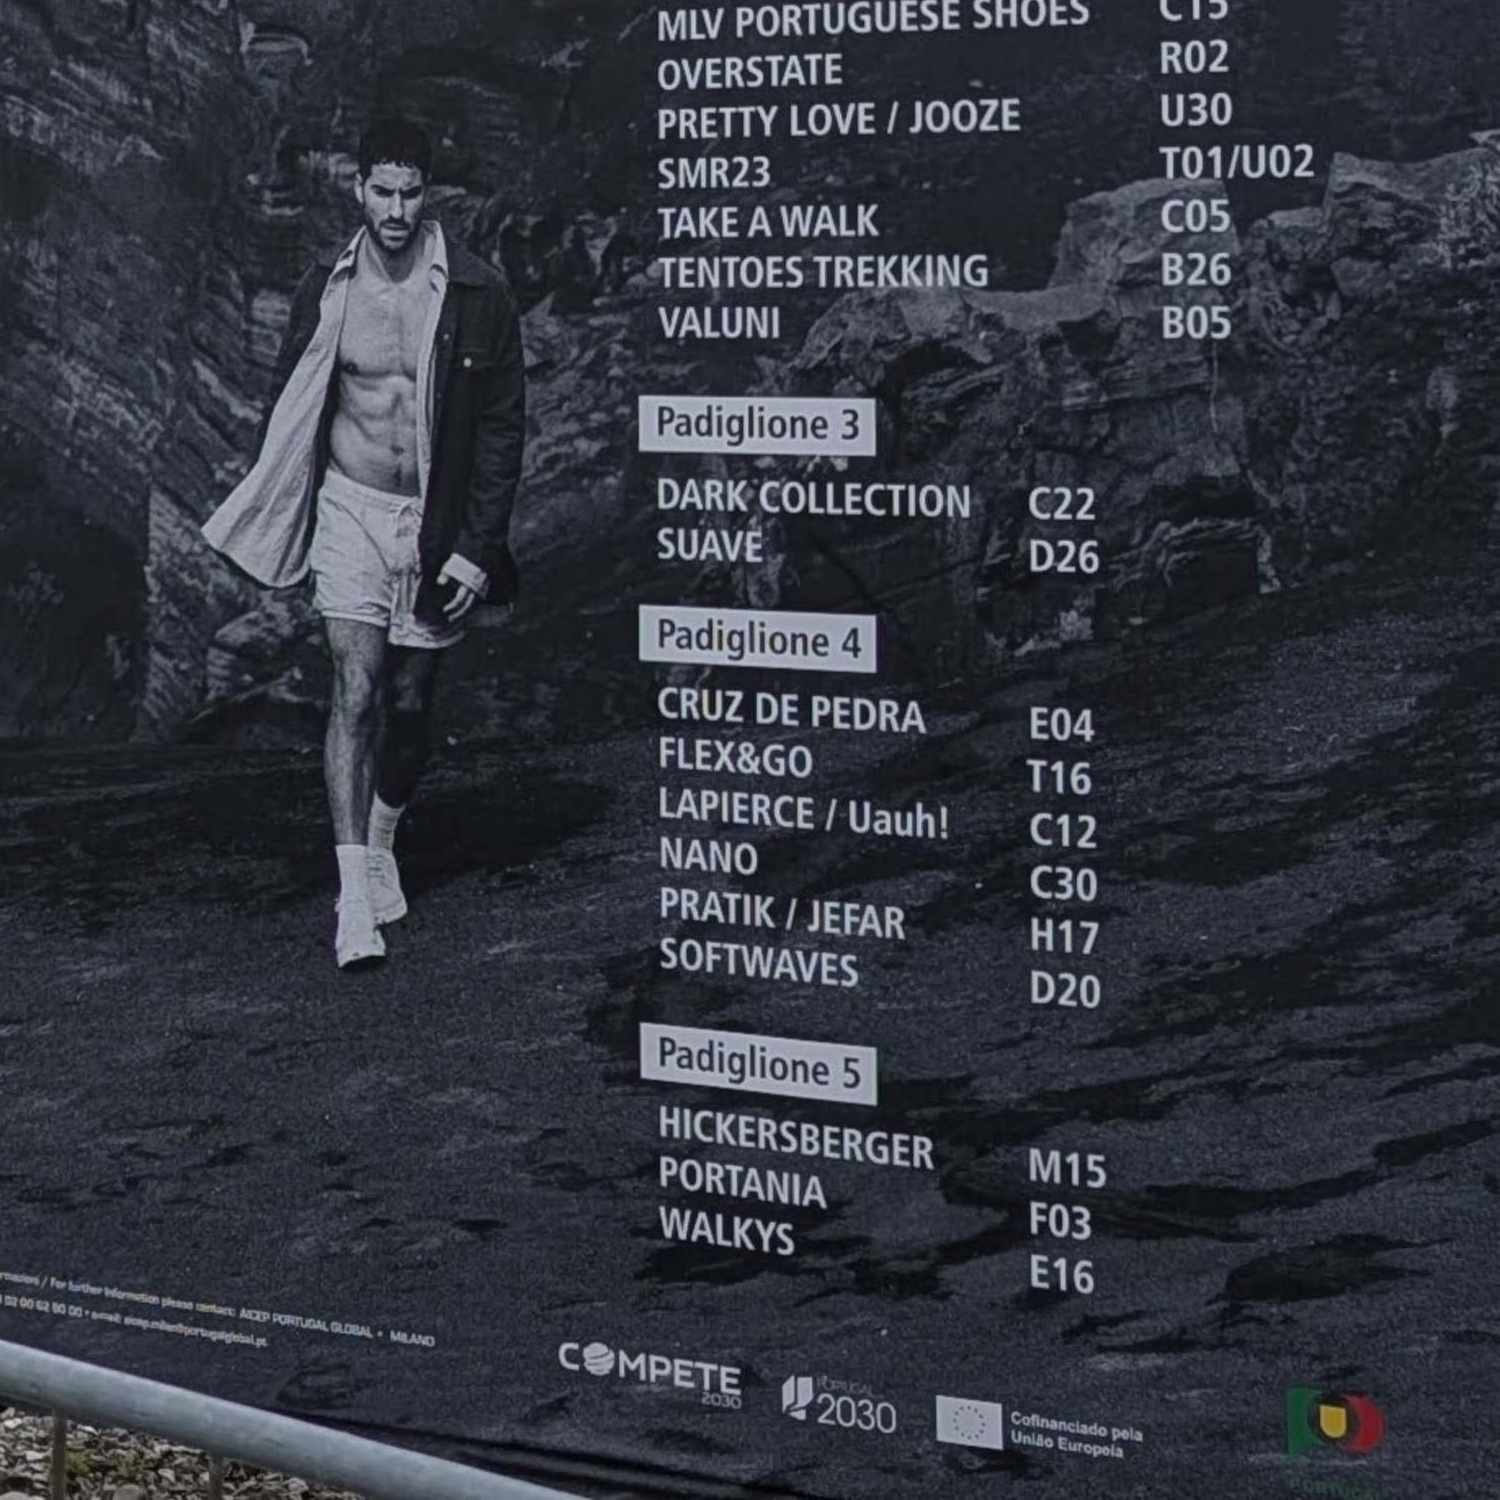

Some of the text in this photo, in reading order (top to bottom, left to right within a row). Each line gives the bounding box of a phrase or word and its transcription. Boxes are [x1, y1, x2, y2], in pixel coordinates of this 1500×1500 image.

[658, 7, 725, 42] MLV
[658, 53, 843, 91] OVERSTATE
[1160, 38, 1229, 74] R02
[658, 105, 779, 140] PRETTY
[790, 102, 876, 136] LOVE
[909, 97, 1021, 134] JOOZE
[1161, 92, 1233, 127] U30
[658, 155, 771, 190] SMR23
[1159, 143, 1315, 181] T01/U02
[657, 204, 879, 239] TAKE A WALK
[1161, 199, 1231, 232] C05
[658, 253, 990, 289] TENTOES TREKKING
[1161, 252, 1231, 286] B26
[658, 306, 781, 339] VALUNI
[1162, 305, 1231, 339] B05
[657, 404, 859, 447] Padiglione 3
[658, 478, 971, 519] DARK COLLECTION
[1029, 487, 1096, 521] C22
[657, 527, 765, 563] SUAVE
[1029, 540, 1100, 574] D26
[658, 618, 862, 662] Padiglione 4
[658, 686, 927, 734] CRUZ DE PEDRA
[1030, 706, 1095, 742] E04
[659, 736, 813, 778] FLEX&GO
[1026, 759, 1092, 795] T16
[659, 786, 815, 830] LAPIERCE
[849, 800, 948, 839] Uauh!
[1030, 812, 1097, 849] C12
[660, 836, 758, 875] NANO
[1030, 865, 1098, 902] C30
[660, 886, 776, 928] PRATIK
[807, 899, 905, 940] JEFAR
[1031, 917, 1099, 955] H17
[660, 936, 859, 988] SOFTWAVES
[1031, 970, 1101, 1009] D20
[659, 1036, 861, 1089] Padiglione 5
[659, 1105, 934, 1170] HICKERSBERGER
[659, 1155, 827, 1209] PORTANIA
[1029, 1147, 1107, 1189] M15
[658, 1205, 795, 1256] WALKYS
[1030, 1201, 1092, 1241] F03
[1030, 1254, 1095, 1295] E16
[272, 1313, 329, 1332] PORTUGAL
[331, 1321, 374, 1339] GLOBAL
[390, 1330, 435, 1347] MILANO
[701, 1392, 742, 1409] 2030
[817, 1394, 896, 1433] 2030
[1011, 1411, 1107, 1438] Cofinanciado
